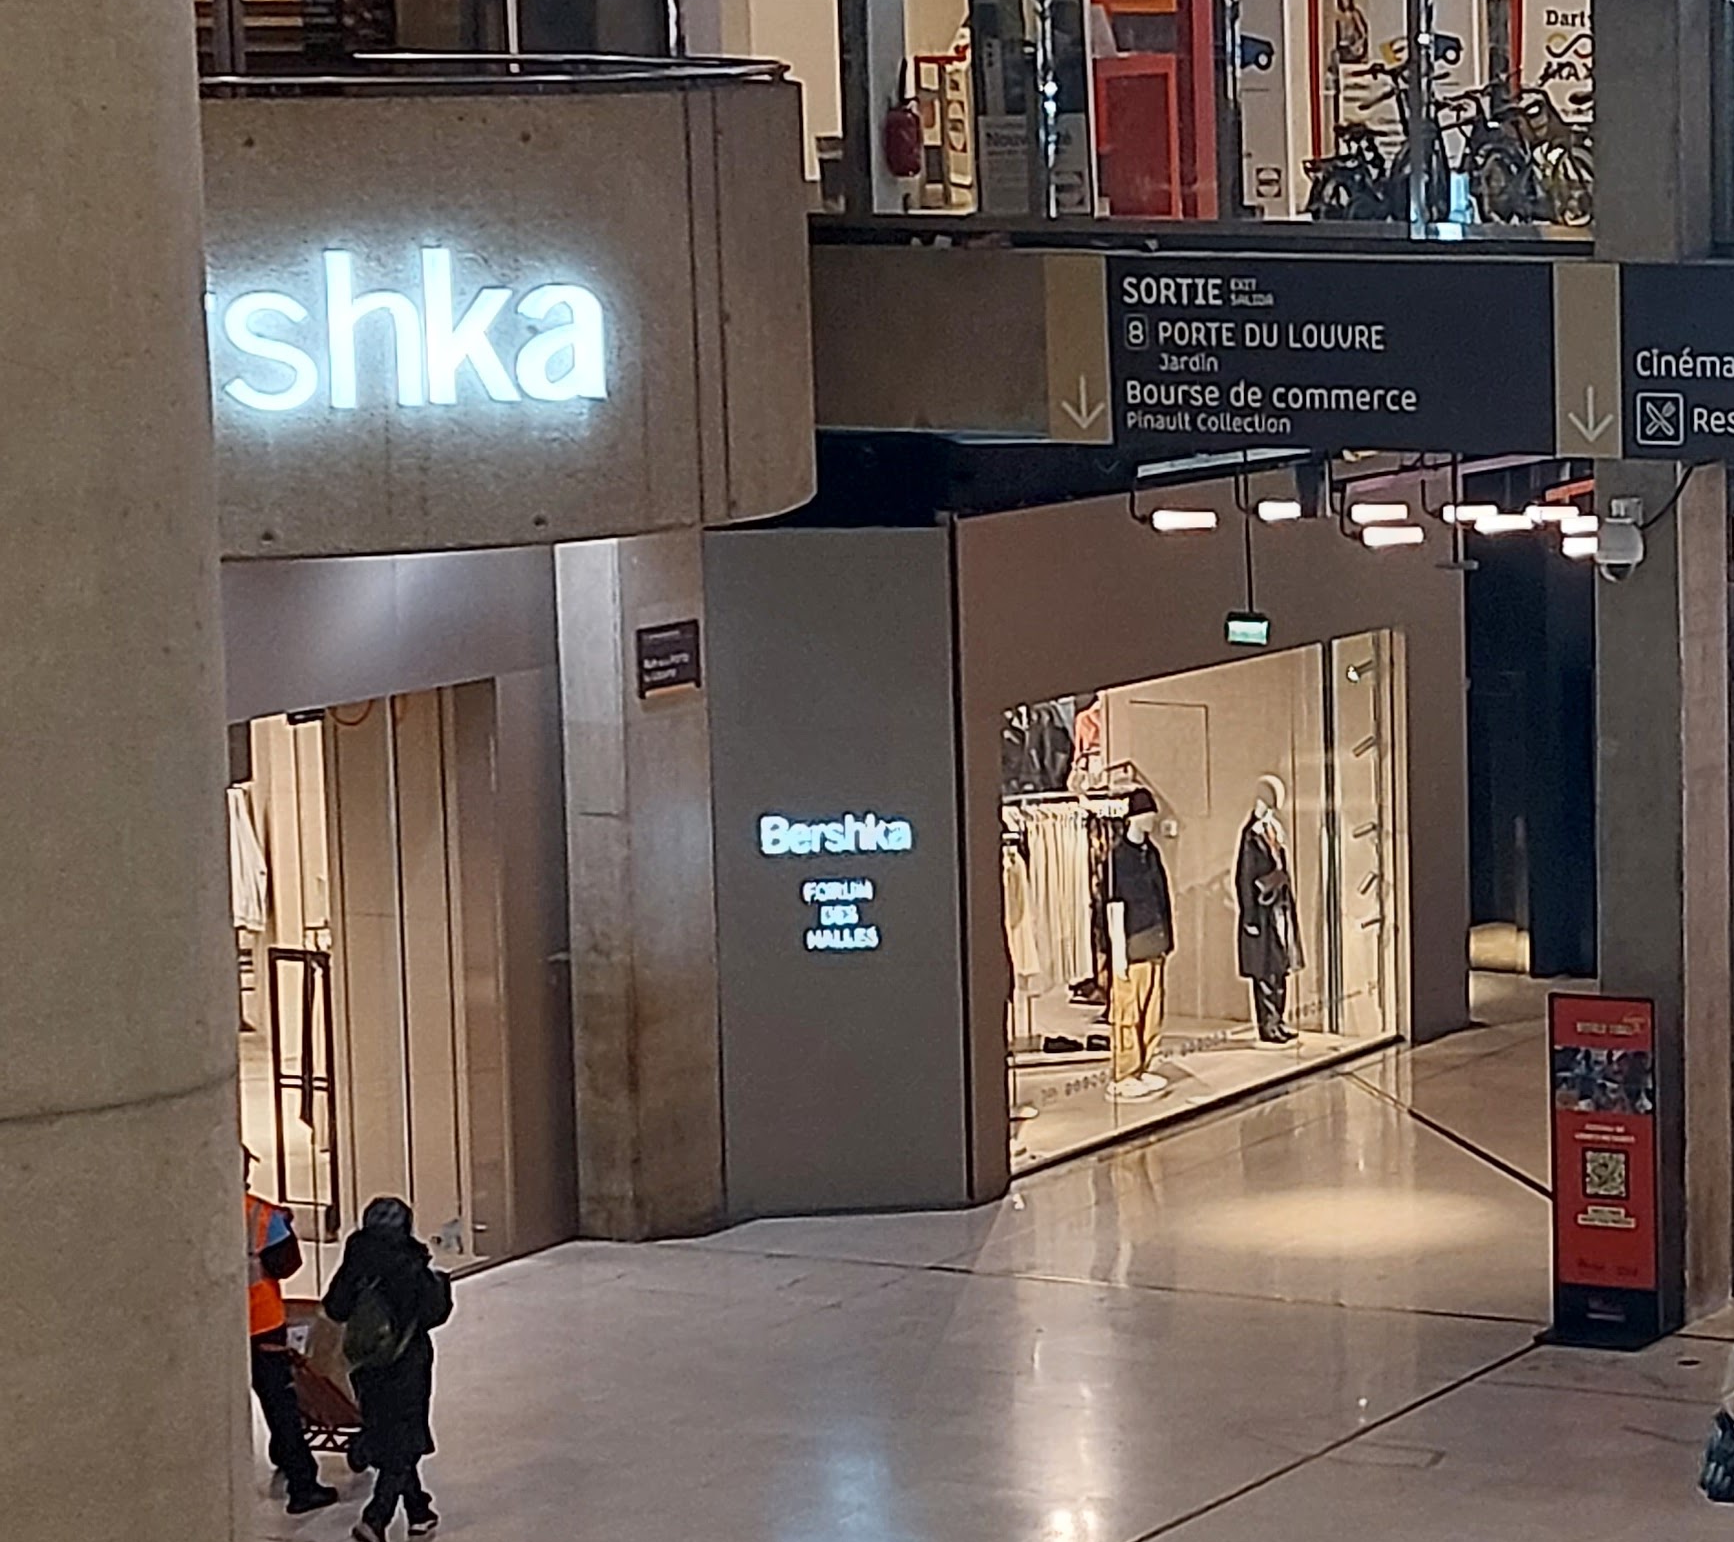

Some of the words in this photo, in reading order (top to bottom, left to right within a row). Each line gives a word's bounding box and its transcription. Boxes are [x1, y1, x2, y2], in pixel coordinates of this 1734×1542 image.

[1123, 276, 1223, 305] SORTIE
[1230, 278, 1257, 291] EXIT
[1230, 293, 1275, 306] SALIDA
[1128, 323, 1144, 344] 8
[1158, 321, 1236, 348] PORTE
[1245, 322, 1279, 349] DU
[1288, 324, 1385, 351] LOUVRE
[1158, 352, 1219, 373] Jardin
[1126, 380, 1220, 407] Bourse
[1230, 381, 1263, 408] de
[1272, 385, 1418, 411] commerce
[1127, 411, 1191, 432] Pinault
[1197, 413, 1291, 434] Collection
[760, 813, 912, 854] Bershka
[802, 879, 874, 903] FORUM
[820, 905, 858, 925] DES
[805, 926, 878, 950] HALLES
